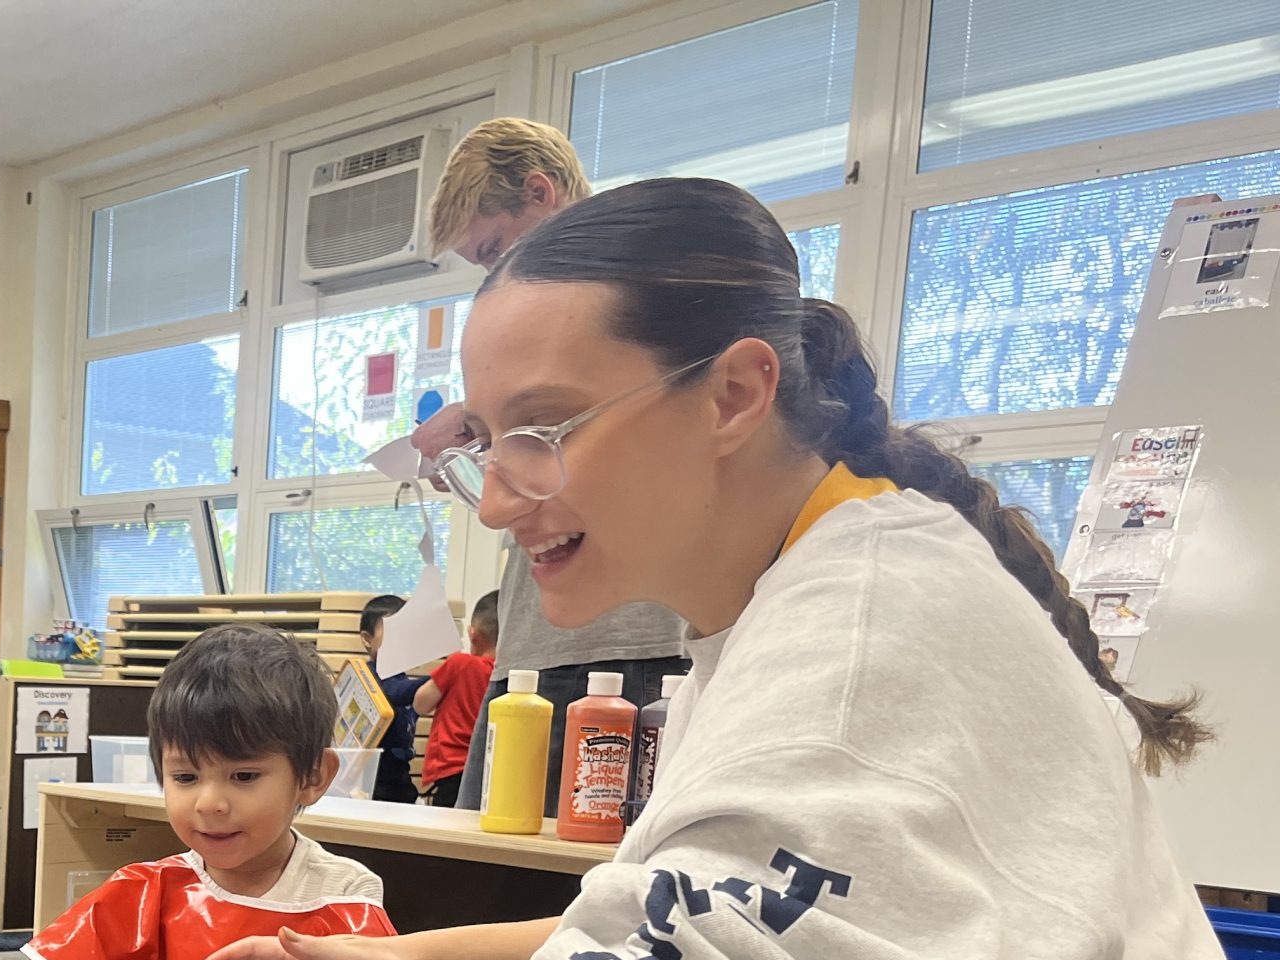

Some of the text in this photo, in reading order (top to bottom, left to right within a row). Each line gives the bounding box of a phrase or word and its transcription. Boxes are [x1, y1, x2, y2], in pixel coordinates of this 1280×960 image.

[1131, 436, 1182, 452] Easel
[33, 690, 72, 700] Discovery
[590, 763, 624, 777] Liquid
[589, 800, 619, 812] Orange
